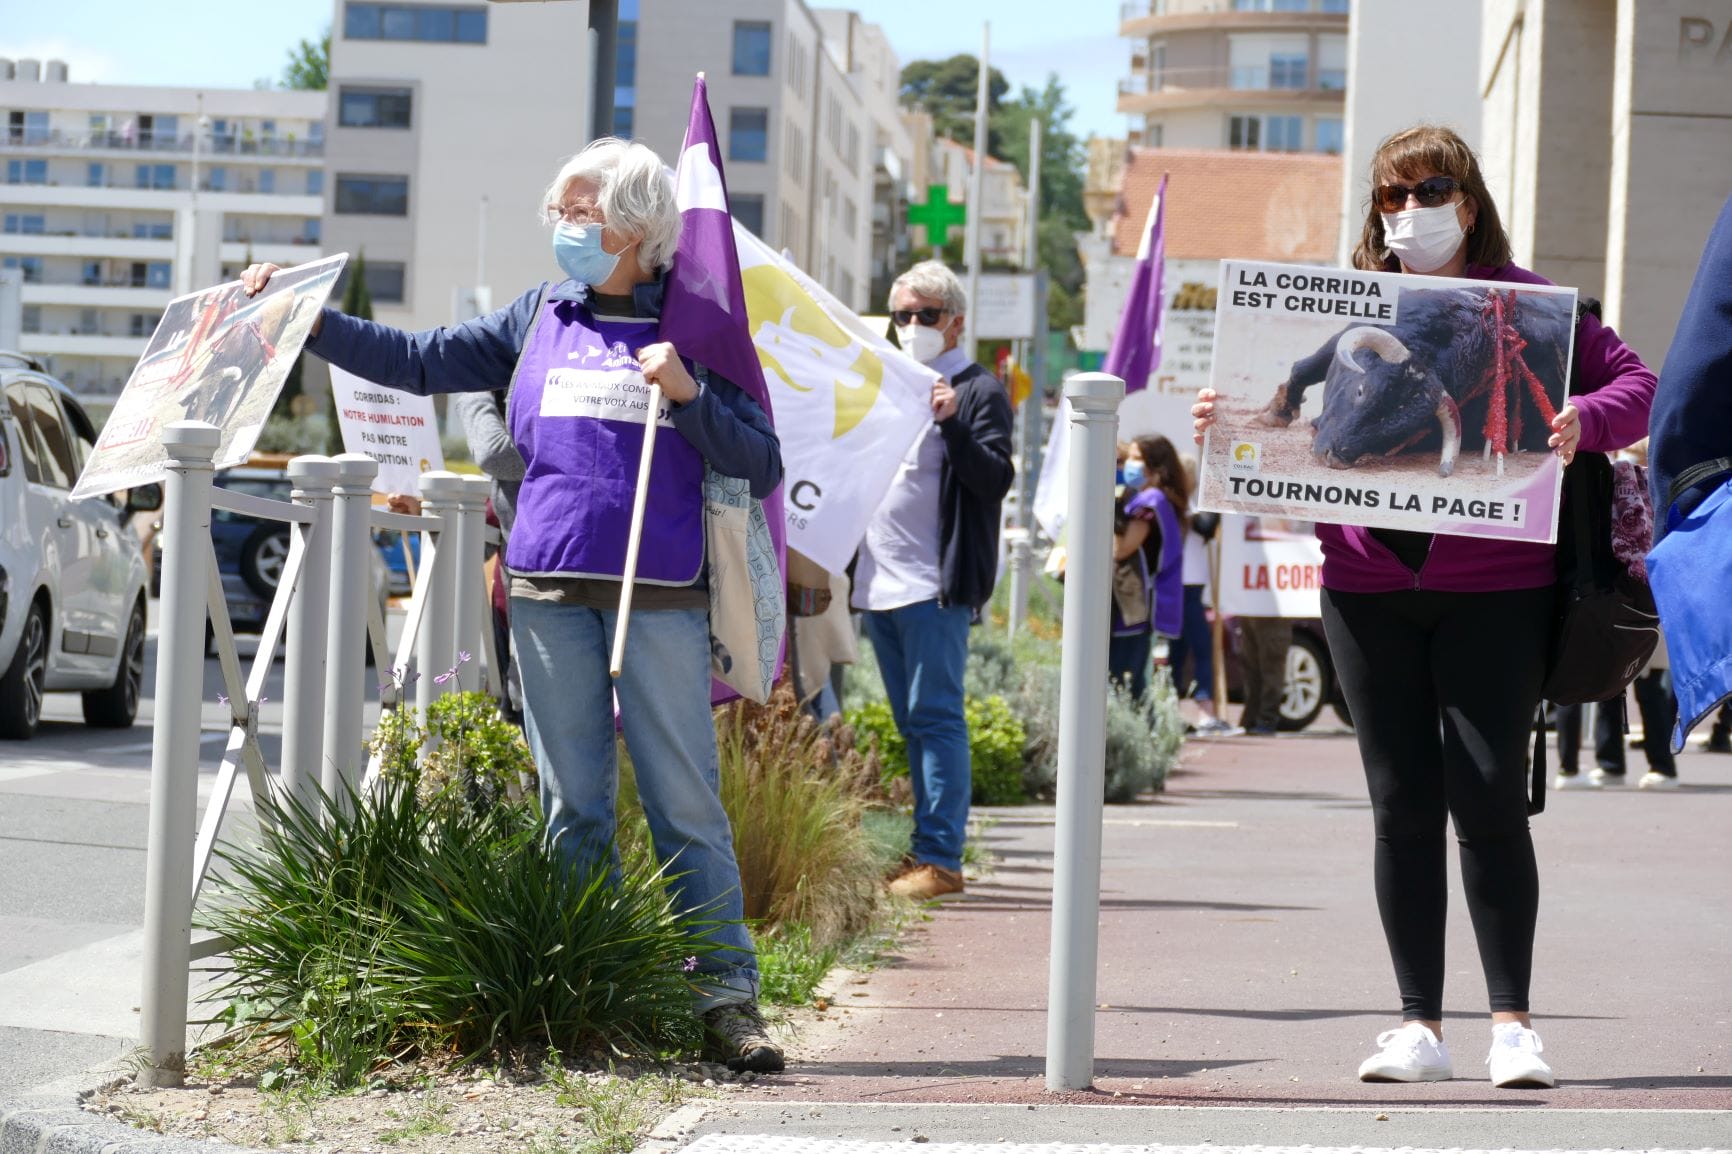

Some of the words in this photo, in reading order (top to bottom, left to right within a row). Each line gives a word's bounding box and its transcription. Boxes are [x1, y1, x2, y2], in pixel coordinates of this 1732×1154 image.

[1239, 270, 1268, 288] LA
[1276, 273, 1382, 298] CORRIDA
[1232, 290, 1277, 309] EST
[1284, 295, 1392, 319] CRUELLE
[353, 391, 395, 405] CORRIDAS
[573, 395, 602, 406] VOTRE
[604, 397, 628, 409] VOIX
[343, 409, 367, 422] NOTRE
[368, 413, 424, 426] HUMILATION
[361, 432, 375, 444] PAS
[377, 434, 408, 447] NOTRE
[1229, 476, 1380, 508] TOURNONS
[1389, 492, 1422, 512] LA
[1431, 496, 1505, 520] PAGE
[1243, 563, 1269, 591] LA
